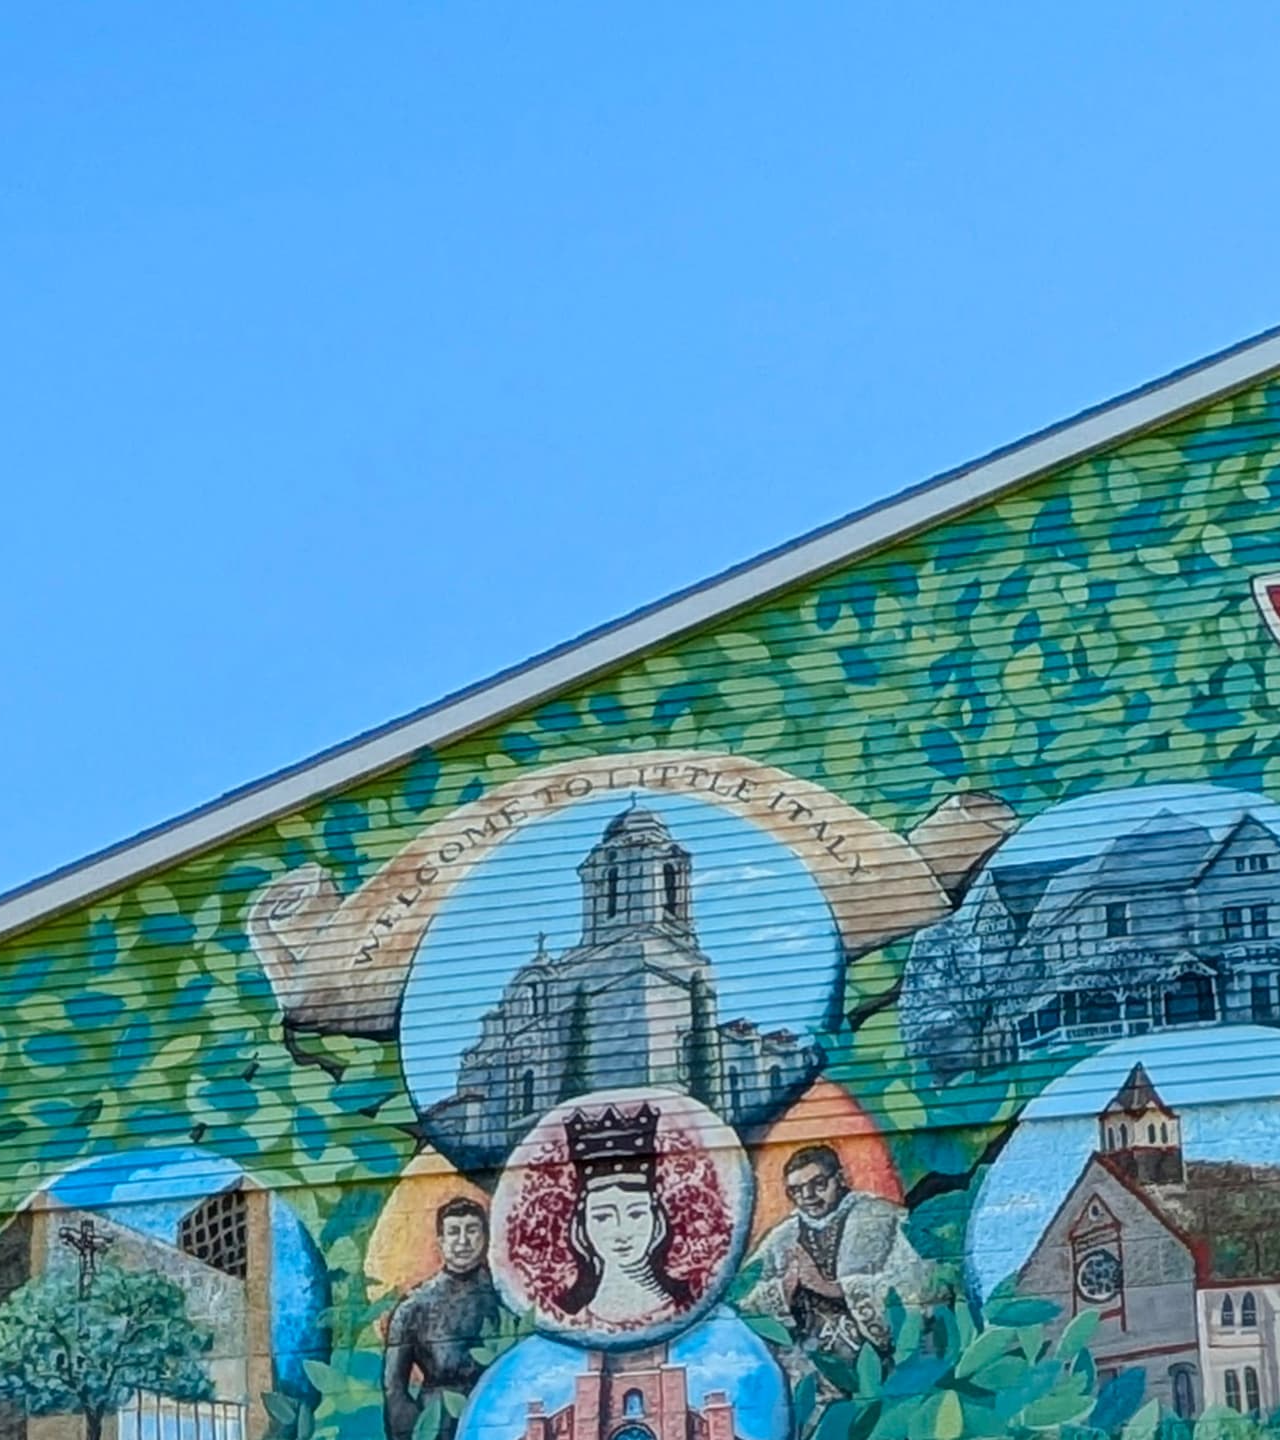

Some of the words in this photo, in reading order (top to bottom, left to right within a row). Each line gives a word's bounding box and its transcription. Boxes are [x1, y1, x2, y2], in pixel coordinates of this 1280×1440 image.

[353, 799, 529, 965] WELCOME
[533, 777, 594, 804] TO
[608, 766, 758, 803] LITTLE
[769, 790, 872, 878] ITALY
